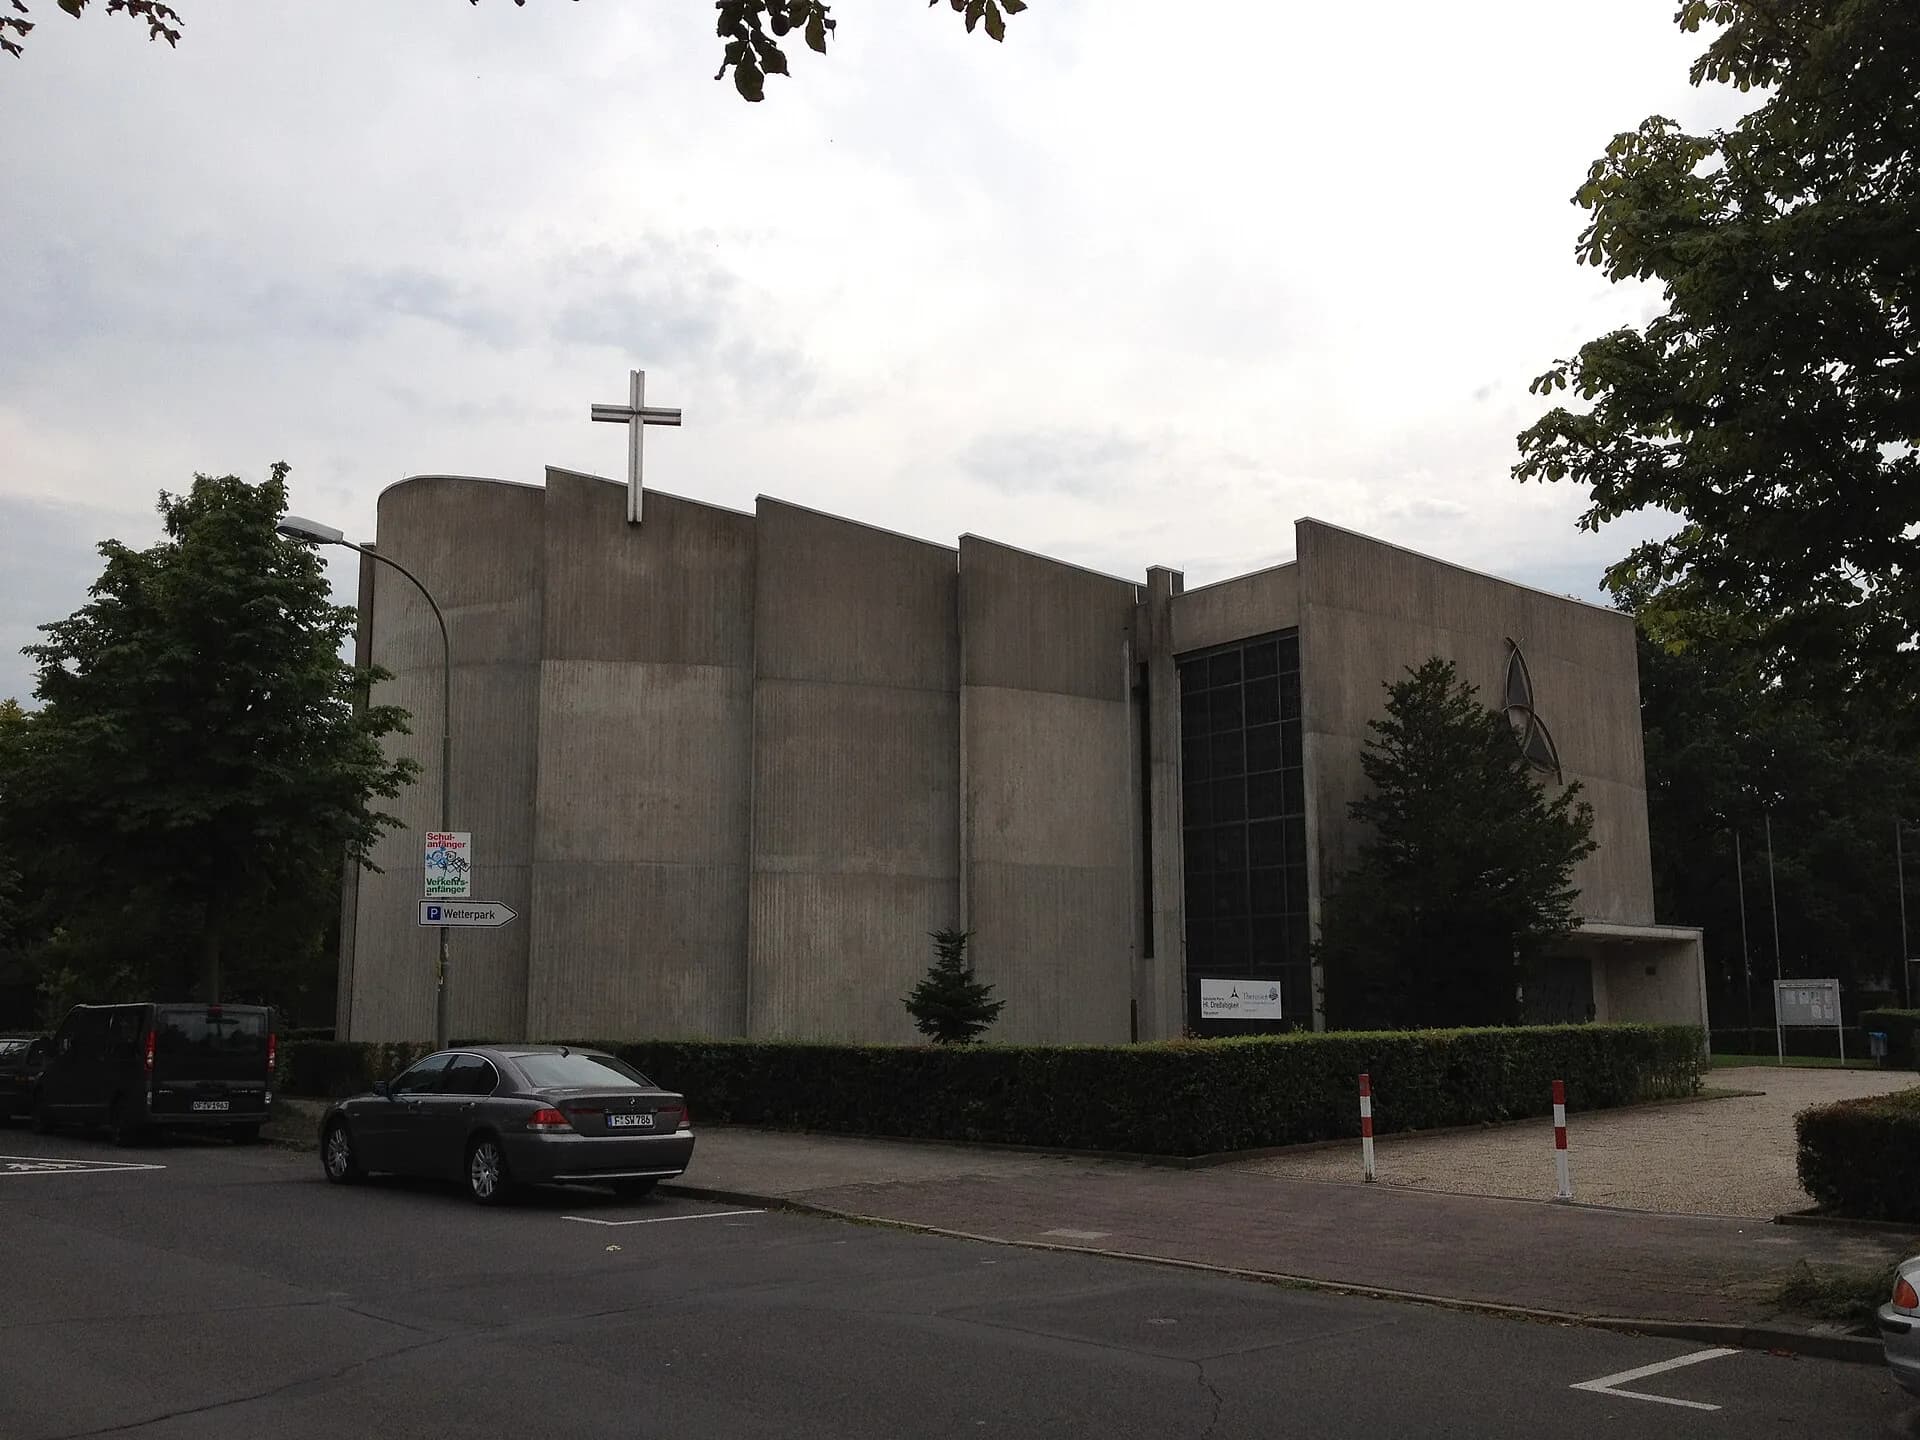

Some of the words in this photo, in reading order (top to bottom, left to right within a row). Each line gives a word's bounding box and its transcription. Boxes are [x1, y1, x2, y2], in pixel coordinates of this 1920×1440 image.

[427, 832, 455, 841] Schul-
[427, 840, 465, 849] anfänger
[426, 878, 469, 886] Verkehrs-
[426, 885, 466, 894] anfänger
[443, 909, 495, 921] Wetterpark
